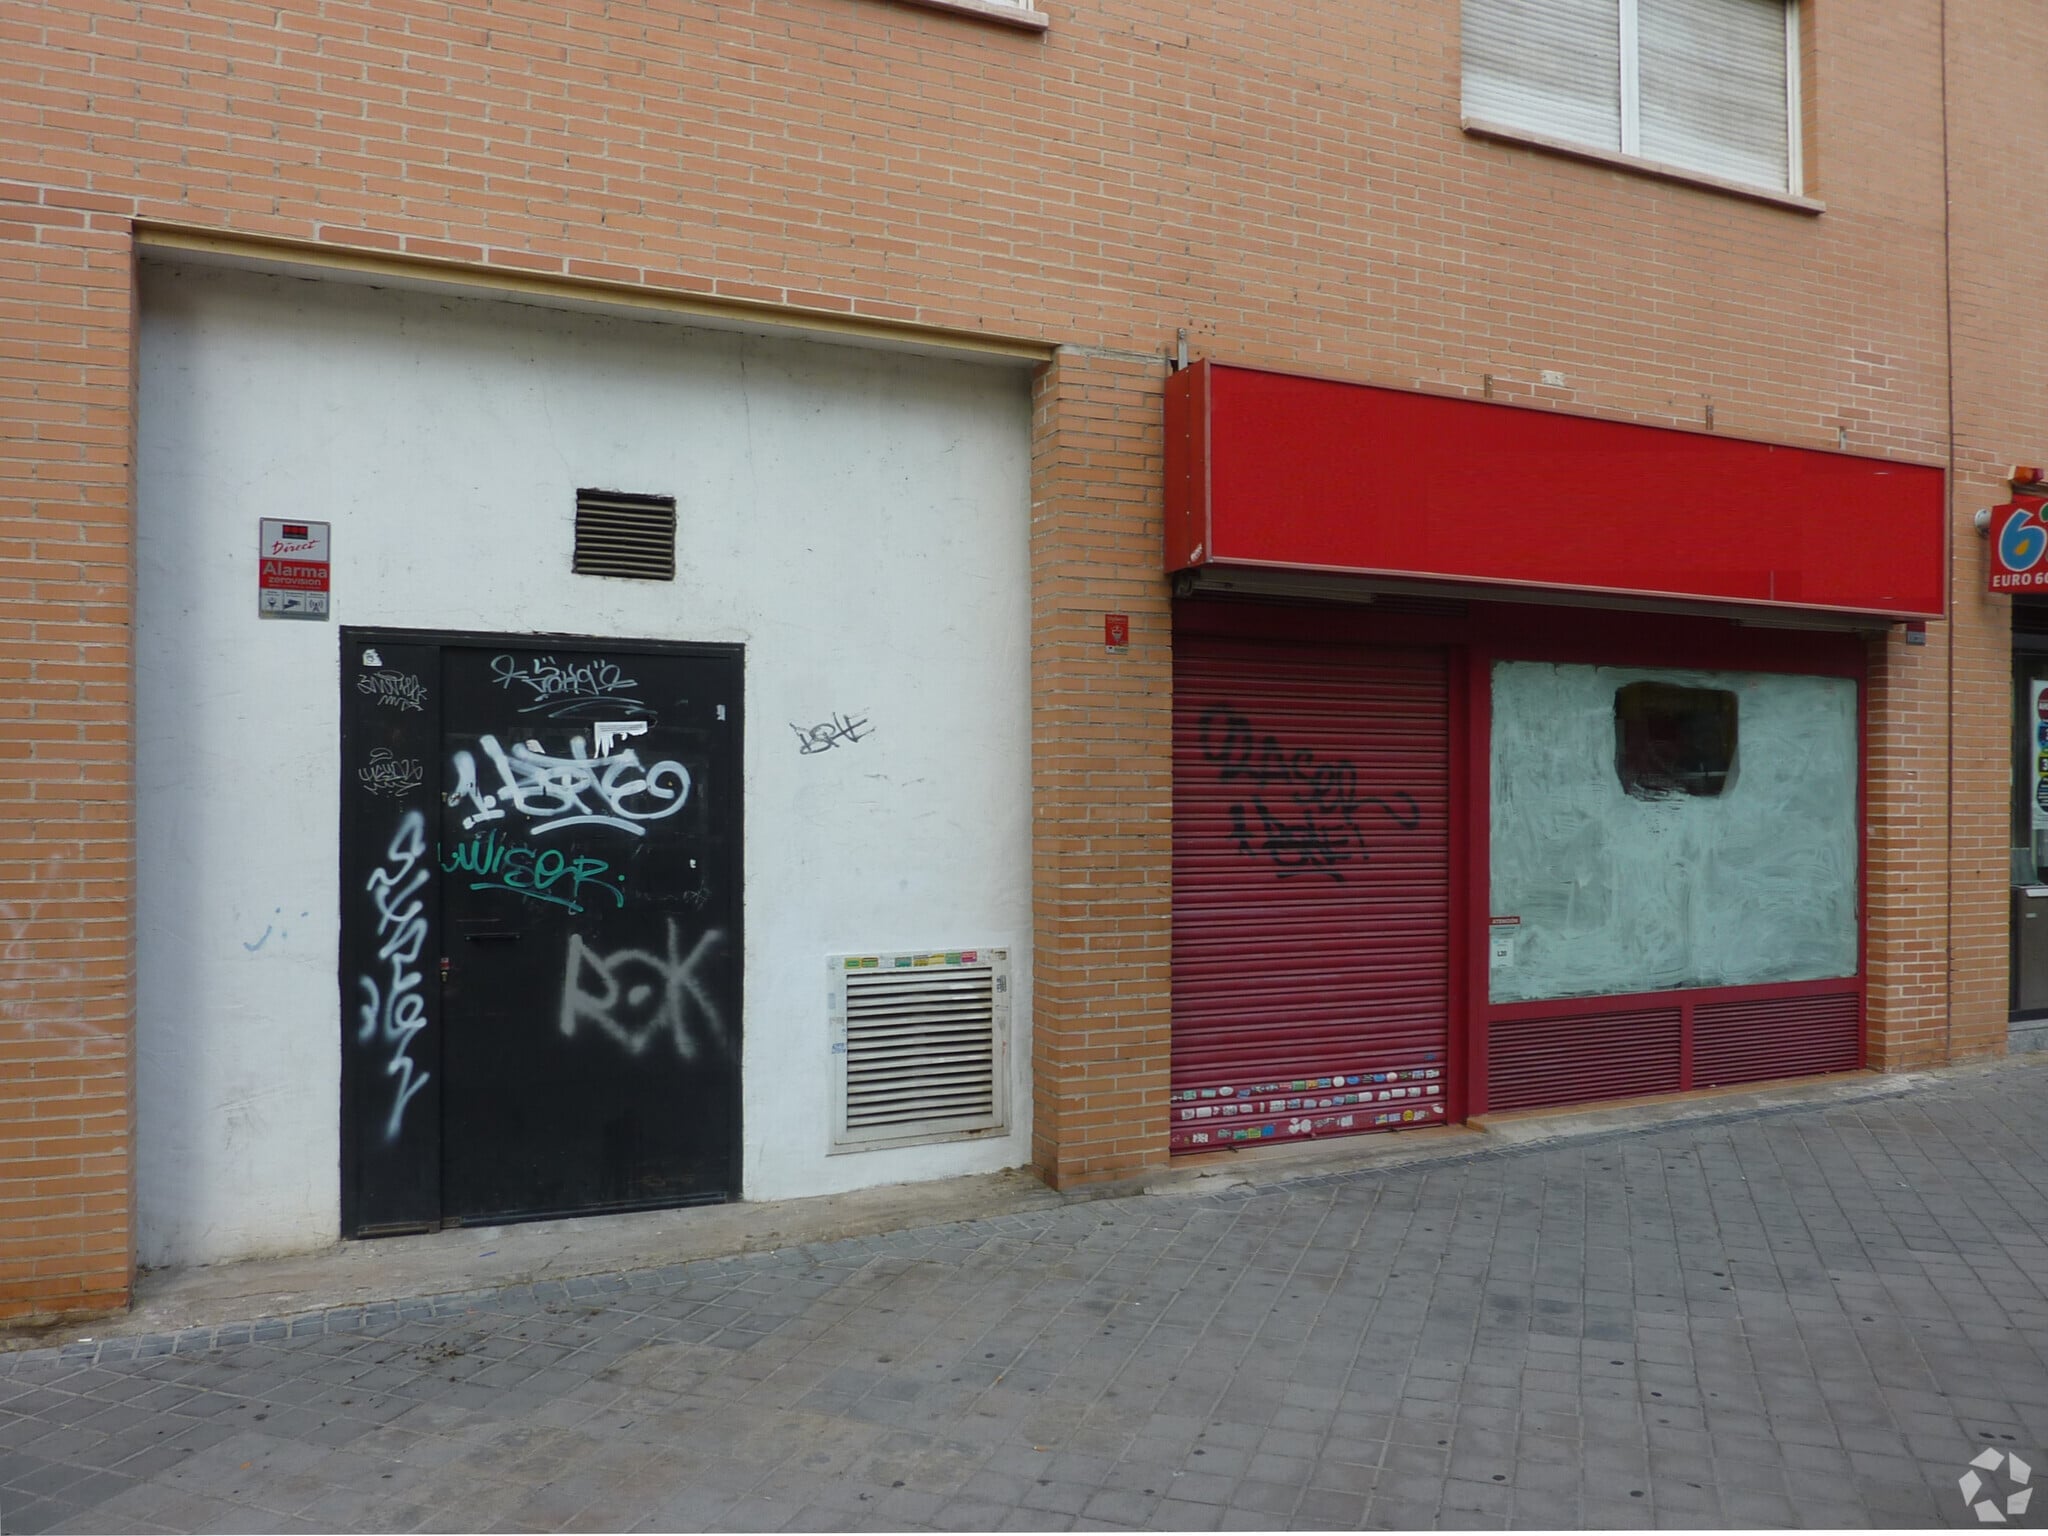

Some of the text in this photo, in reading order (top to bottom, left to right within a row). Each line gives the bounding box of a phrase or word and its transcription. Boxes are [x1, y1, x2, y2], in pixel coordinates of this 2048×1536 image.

[271, 539, 321, 555] Direct
[263, 561, 328, 578] Alarma
[1992, 573, 2032, 587] EURO
